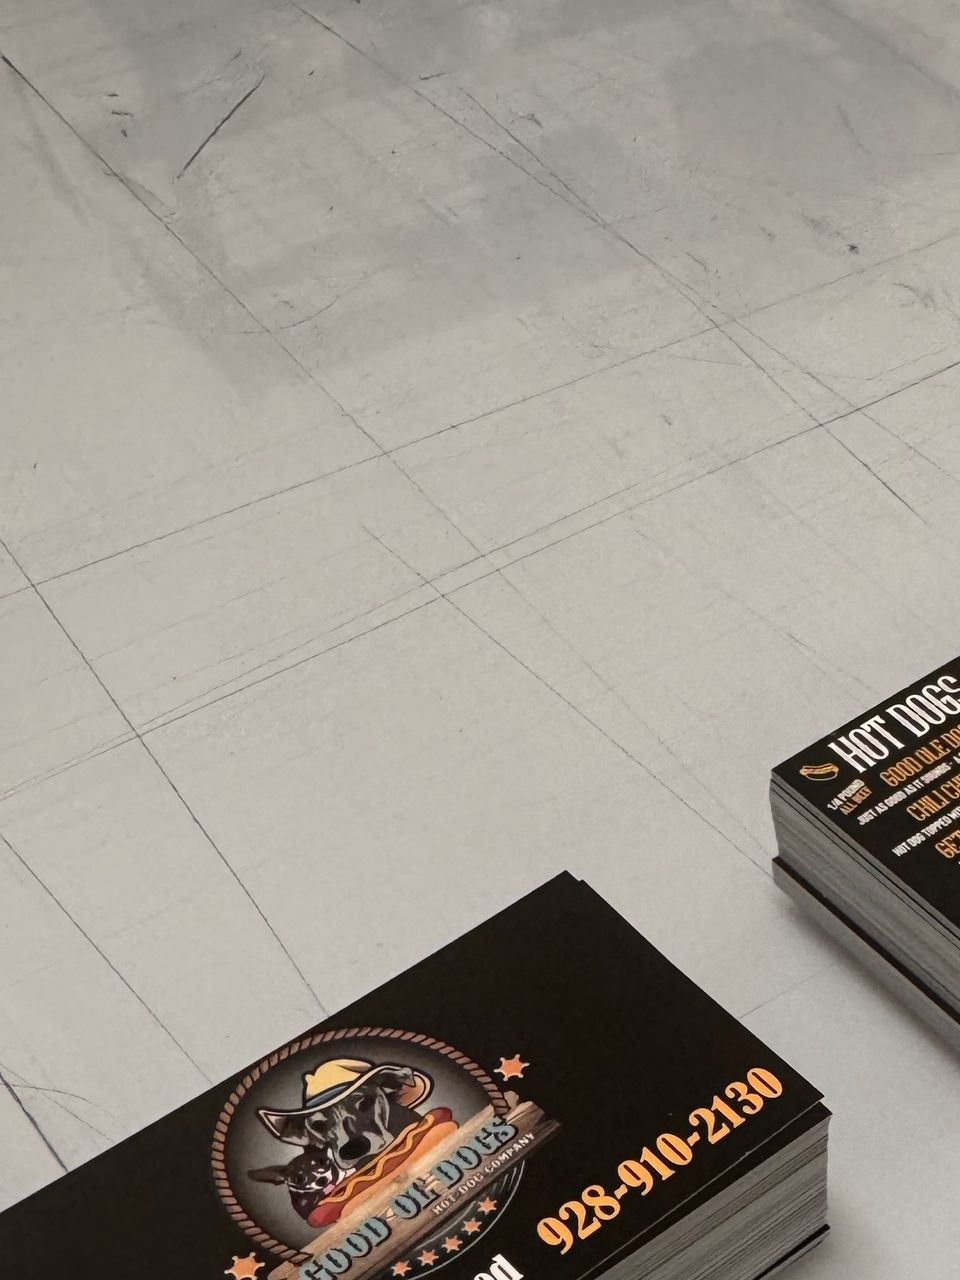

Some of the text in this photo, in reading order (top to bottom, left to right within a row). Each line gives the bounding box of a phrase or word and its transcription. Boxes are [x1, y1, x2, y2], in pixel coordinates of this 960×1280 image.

[827, 714, 906, 774] HOT
[879, 756, 924, 787] GOOD
[914, 738, 952, 765] OLE
[906, 789, 951, 822] CHILI
[431, 1114, 519, 1190] DOGS
[431, 1132, 535, 1216] HOT DOG COMPANY
[537, 1068, 782, 1254] 928-910-2130
